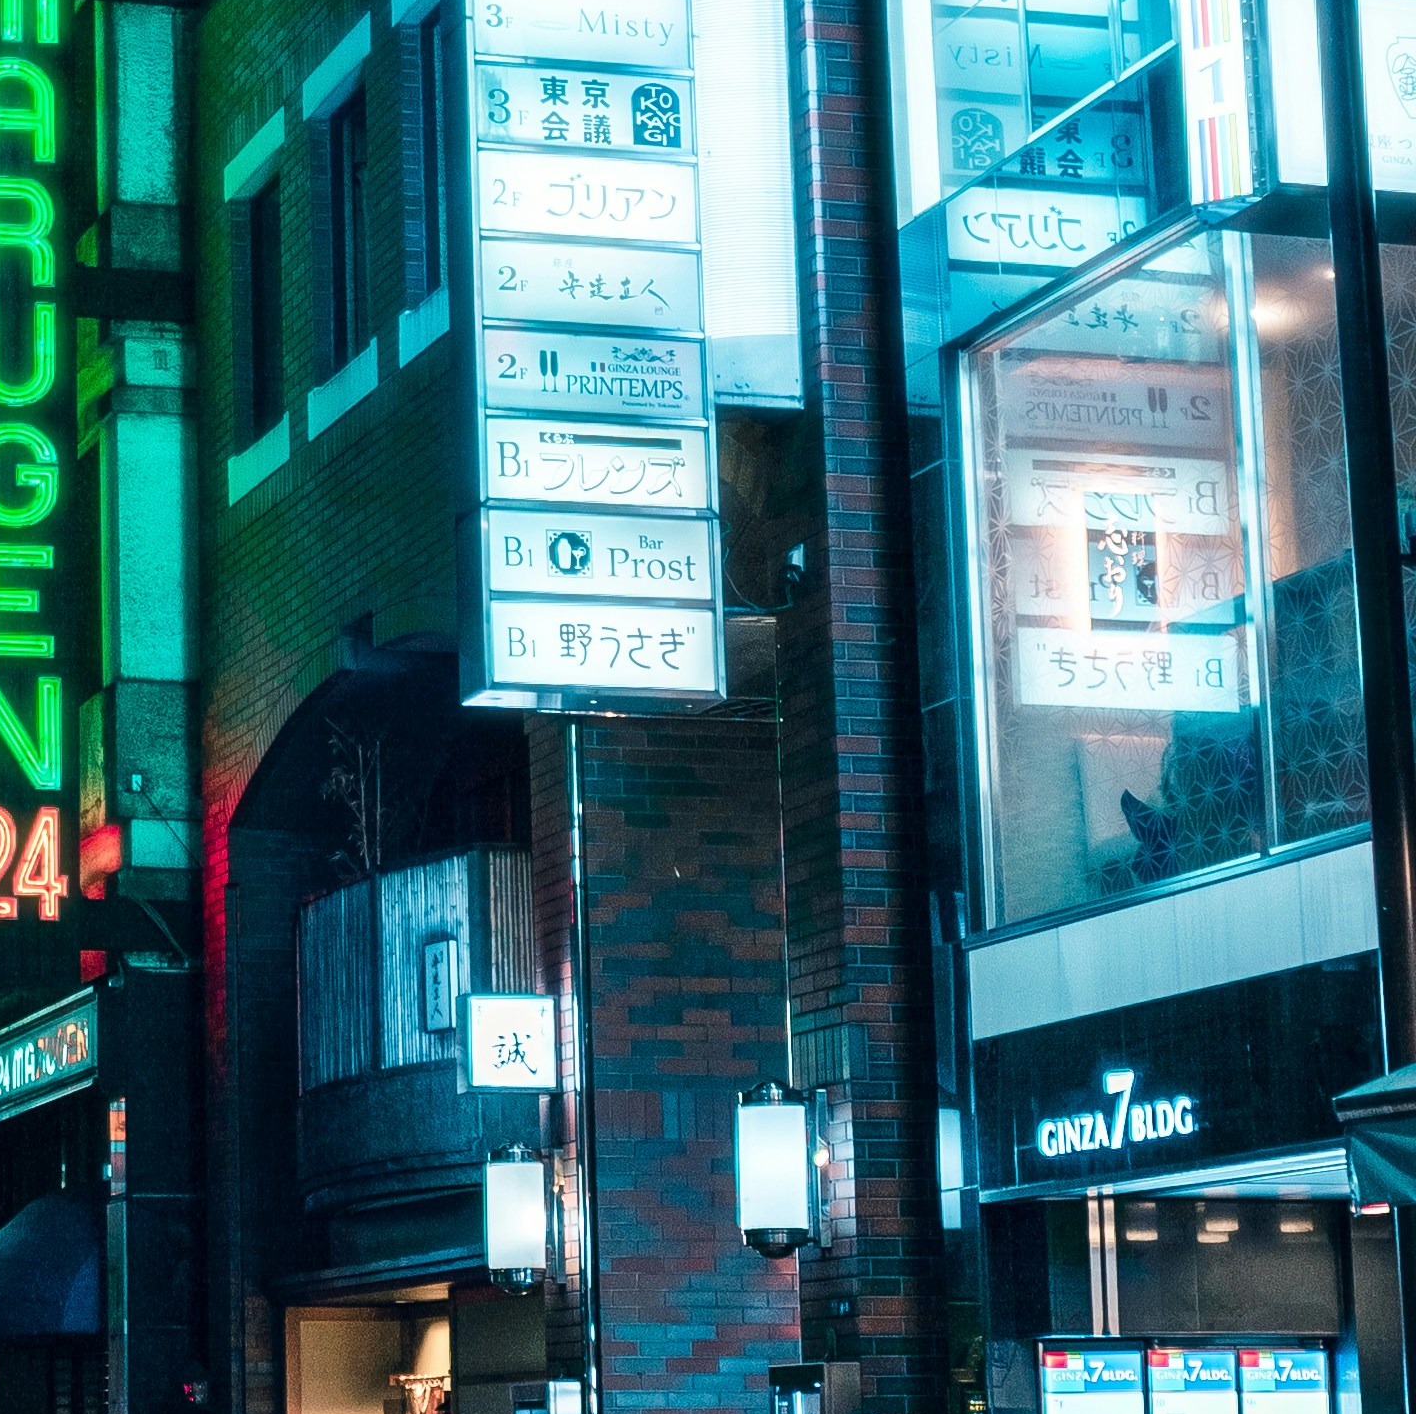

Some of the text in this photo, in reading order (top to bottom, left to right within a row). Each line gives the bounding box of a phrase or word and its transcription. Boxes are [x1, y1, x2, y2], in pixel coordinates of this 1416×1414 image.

[485, 3, 675, 47] 3F Misty
[487, 87, 529, 126] 3F
[539, 75, 611, 109] 東京
[540, 111, 613, 146] 会議
[492, 178, 522, 208] 2F
[498, 265, 529, 292] 2F
[497, 353, 682, 380] 2F GINZA LOUNGE
[565, 374, 684, 401] PRINTEMPS
[638, 535, 665, 550] Bar
[606, 547, 697, 582] Prost
[559, 623, 697, 671] 野うさぎ
[491, 1032, 538, 1076] 誠
[1037, 1113, 1109, 1158] GINZA
[1102, 1069, 1136, 1150] 7
